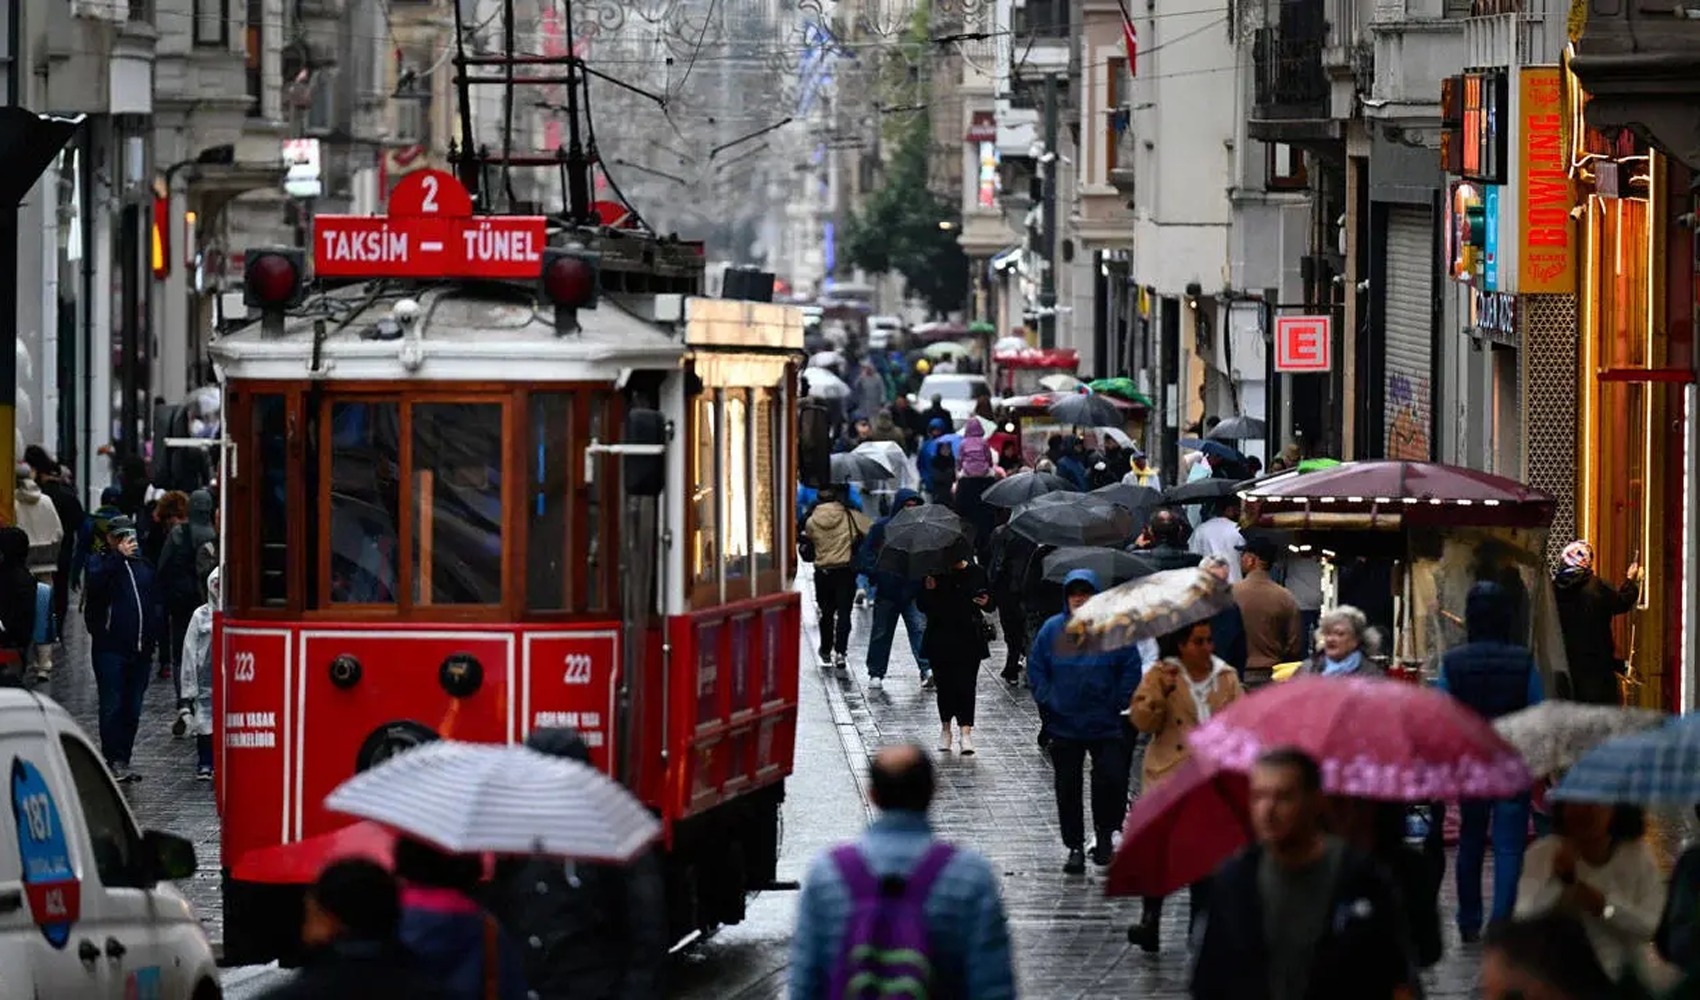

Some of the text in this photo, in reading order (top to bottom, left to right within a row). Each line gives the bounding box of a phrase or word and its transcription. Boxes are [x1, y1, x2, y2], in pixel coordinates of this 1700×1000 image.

[421, 175, 439, 212] 2
[1527, 114, 1568, 247] BOWLING
[322, 223, 408, 262] TAKSİM
[463, 222, 539, 261] TÜNEL
[1289, 327, 1317, 359] E
[234, 651, 254, 681] 223
[564, 653, 591, 684] 223
[246, 711, 276, 728] YASAK
[23, 793, 52, 841] 187
